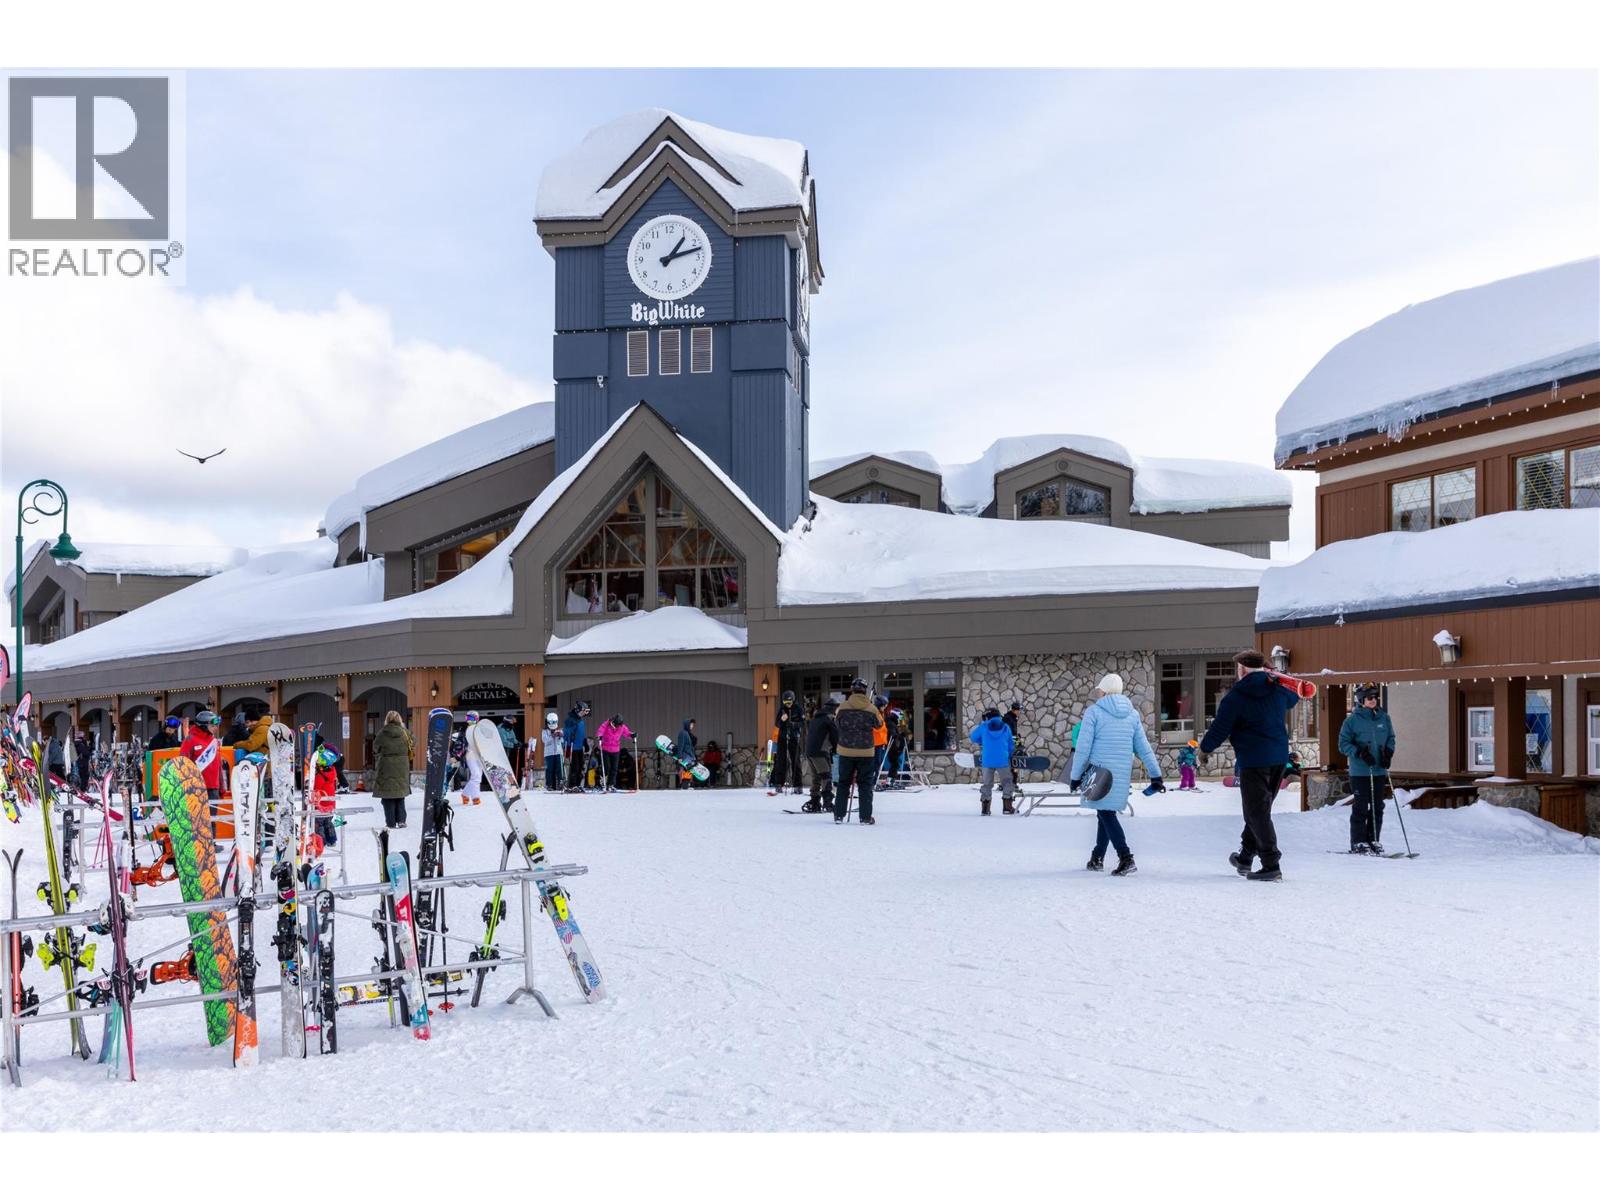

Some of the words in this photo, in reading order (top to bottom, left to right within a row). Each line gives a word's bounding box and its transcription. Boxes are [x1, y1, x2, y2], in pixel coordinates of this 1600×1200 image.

[665, 226, 674, 234] 12
[651, 231, 659, 239] 11
[641, 242, 651, 250] 10
[692, 239, 697, 247] 2
[696, 254, 701, 262] 3
[642, 271, 648, 279] 8
[691, 268, 697, 276] 4
[653, 280, 658, 288] 7
[667, 283, 673, 291] 6
[461, 690, 507, 700] RENTALS
